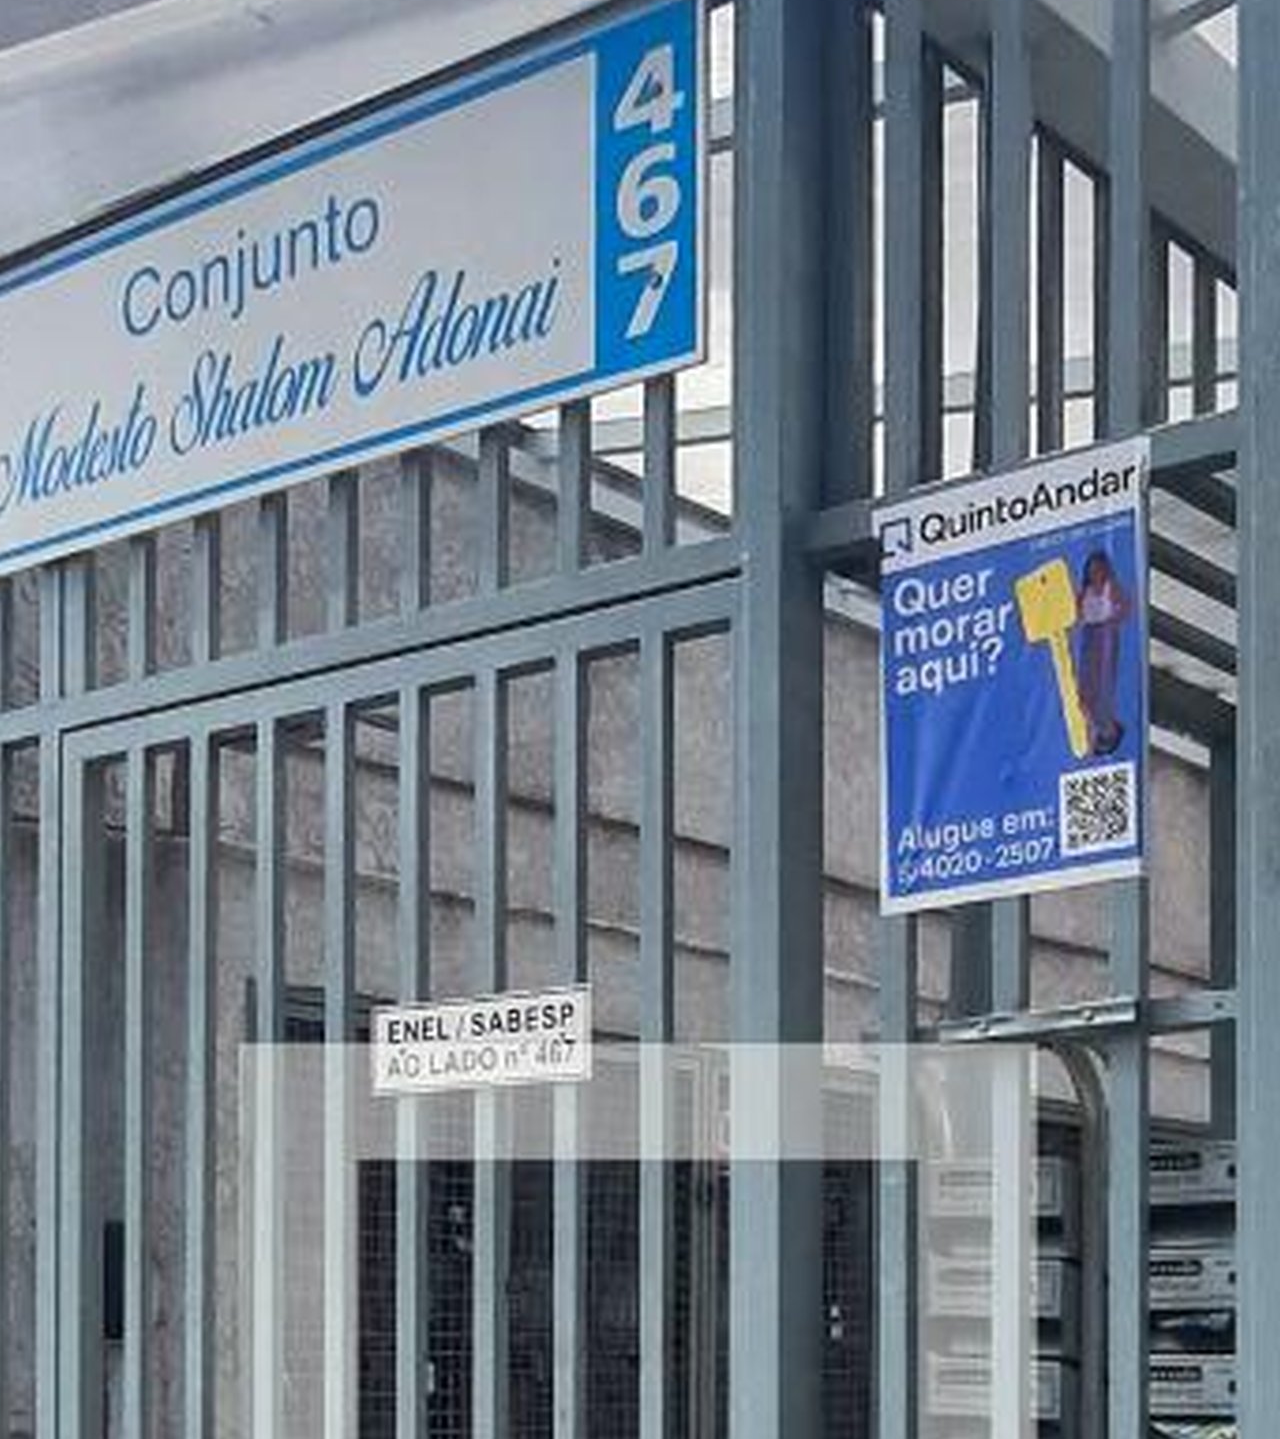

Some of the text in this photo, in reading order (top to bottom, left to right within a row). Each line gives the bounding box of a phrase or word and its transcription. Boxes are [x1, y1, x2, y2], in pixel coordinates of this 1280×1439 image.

[613, 44, 684, 339] 467
[123, 195, 380, 335] Conjunto
[170, 335, 336, 455] Shalom
[354, 270, 560, 397] Adonai
[919, 463, 1136, 546] QuintoAndar
[893, 569, 993, 618] Quer
[894, 603, 1013, 658] morar
[895, 641, 1003, 696] aqui?
[898, 817, 994, 855] Alugue
[388, 1017, 449, 1044] ENEL
[471, 1002, 574, 1036] SABESP
[430, 1047, 496, 1075] LADO
